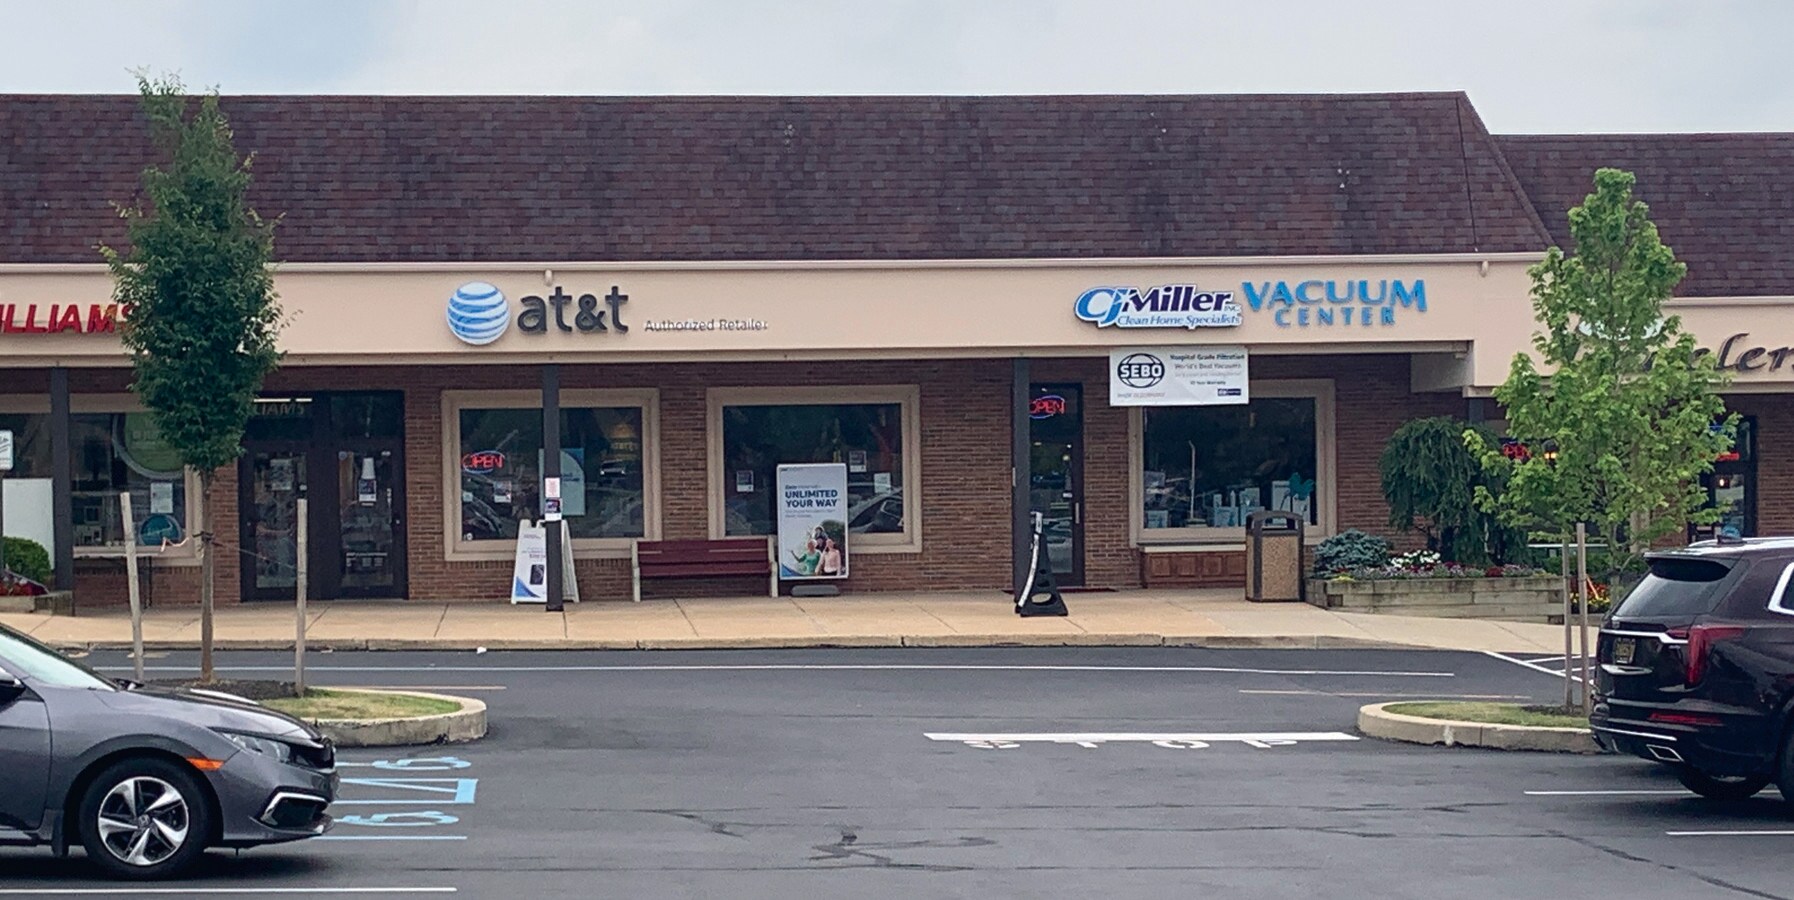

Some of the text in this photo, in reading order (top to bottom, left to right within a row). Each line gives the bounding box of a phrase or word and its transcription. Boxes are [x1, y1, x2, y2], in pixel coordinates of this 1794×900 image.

[1242, 280, 1427, 312] VACUUM
[517, 286, 768, 333] at&t Authorized Retailer
[1275, 306, 1395, 327] CENTER
[1117, 312, 1240, 328] Clean Home Specialists
[1120, 364, 1163, 378] SEBO
[462, 453, 503, 469] OPEN
[785, 489, 838, 499] UNLIMITED
[785, 499, 838, 508] YOUR WAY
